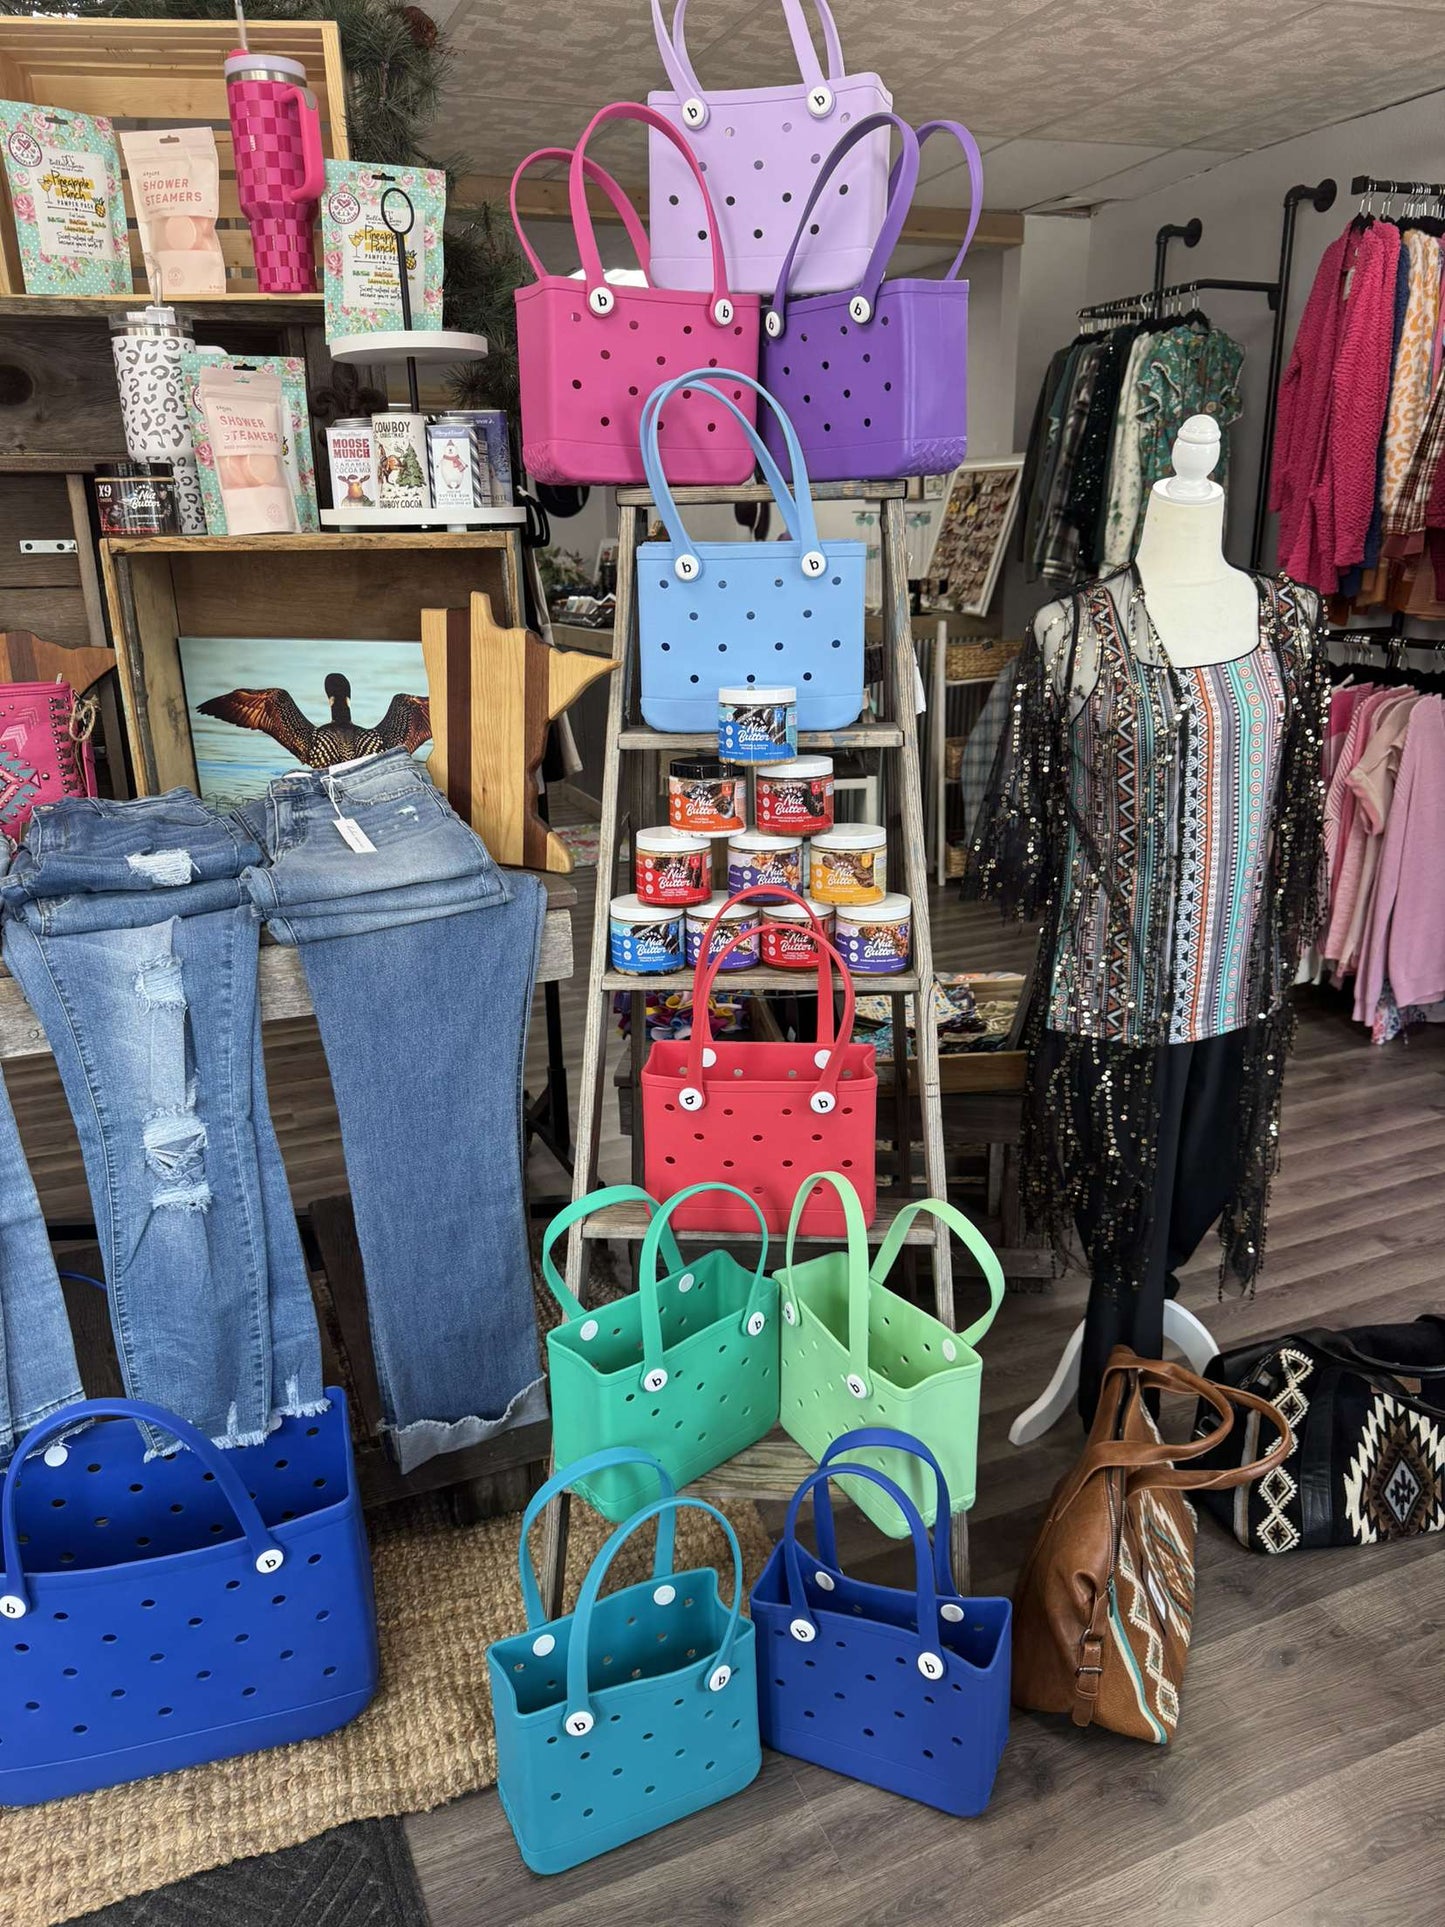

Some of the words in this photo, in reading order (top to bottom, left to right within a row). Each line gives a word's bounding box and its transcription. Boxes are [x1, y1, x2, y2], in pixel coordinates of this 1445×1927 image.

[143, 178, 189, 192] SHOWER
[61, 184, 86, 201] Punch
[145, 191, 202, 206] STEAMERS
[371, 240, 396, 255] Punch
[220, 415, 266, 428] SHOWER
[374, 421, 411, 433] COWBOY
[224, 430, 278, 443] STEAMERS
[332, 438, 370, 449] MOOSE
[333, 448, 371, 459] MUNCH
[138, 489, 157, 500] Nut
[131, 496, 160, 509] Butter
[400, 499, 423, 509] COCOA
[747, 722, 768, 734] Nut
[737, 729, 770, 743] Butter
[694, 795, 715, 807] Nut
[783, 794, 804, 806] Nut
[686, 803, 719, 817] Butter
[774, 802, 808, 816] Butter
[667, 868, 687, 880] Nut
[766, 867, 784, 877] Nut
[834, 867, 856, 878] Nut
[658, 876, 692, 889] Butter
[756, 873, 787, 886] Butter
[827, 873, 858, 886] Butter
[645, 937, 664, 947] Nut
[788, 933, 809, 943] Nut
[873, 938, 893, 949] Nut
[636, 944, 667, 956] Butter
[780, 940, 811, 952] Butter
[863, 945, 896, 958] Butter
